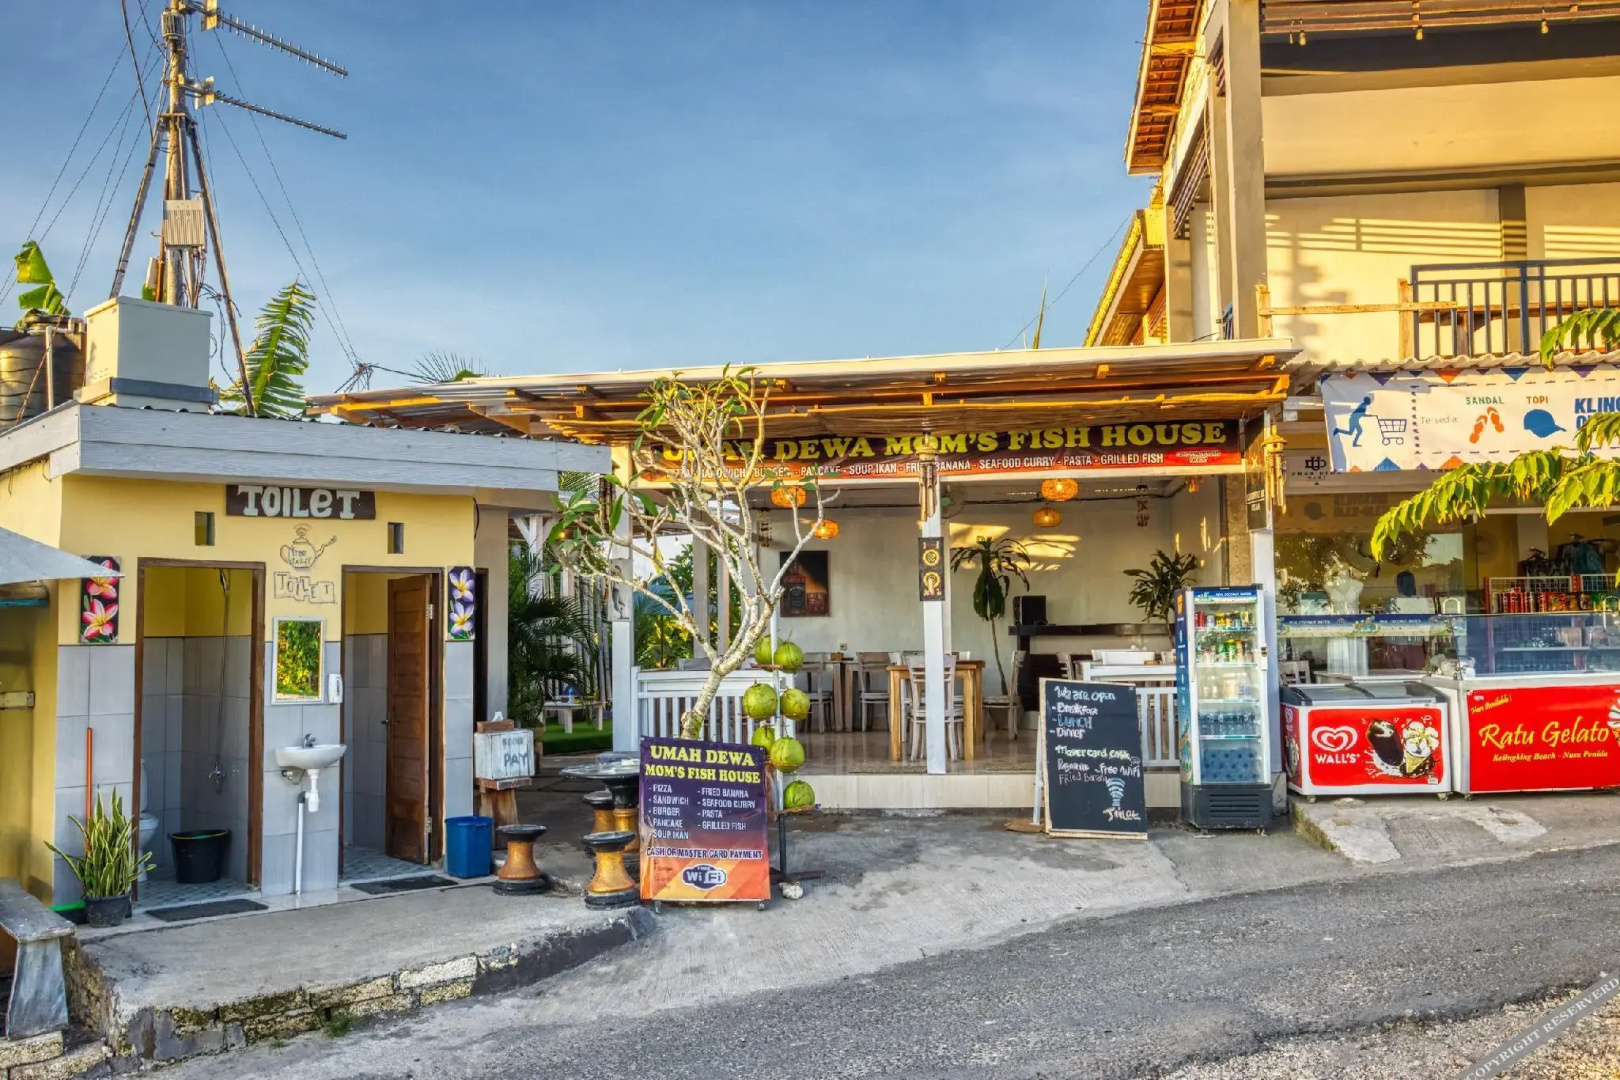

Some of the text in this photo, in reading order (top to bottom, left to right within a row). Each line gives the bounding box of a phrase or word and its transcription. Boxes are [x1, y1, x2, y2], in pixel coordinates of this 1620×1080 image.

[1465, 395, 1549, 405] SANDAL TOPI
[774, 437, 875, 460] DEWA
[885, 431, 998, 455] MOM'S
[1007, 426, 1090, 450] FISH
[1101, 422, 1226, 447] HOUSE
[849, 464, 873, 475] SOUP
[875, 463, 896, 474] IKAN
[979, 458, 1022, 468] SEAFOOD
[1024, 456, 1054, 467] CURRY
[1063, 455, 1093, 466] PASTA
[1101, 454, 1141, 465] GRILLED
[1142, 453, 1163, 463] FISH
[1072, 690, 1090, 700] are
[1091, 691, 1116, 703] open
[1478, 716, 1610, 749] Ratu Gelato
[503, 753, 530, 769] PAY
[650, 745, 755, 766] UMAH DEWA
[1314, 753, 1357, 764] WALL'S
[645, 764, 761, 784] MOM'S FISH HOUSE
[652, 784, 673, 793] PIZZA
[701, 787, 749, 798] FRIED BANANA
[652, 795, 689, 805] SANDWICH
[701, 798, 756, 809] SEAFOOD CURRY
[652, 806, 680, 816] BURGER
[702, 809, 723, 818] PASTA
[652, 818, 683, 828] PANCAKE
[702, 820, 747, 831] GRILLED FISH
[653, 829, 689, 840] SOUP IKAN
[646, 847, 665, 856] CASH
[678, 848, 707, 858] MASTER
[709, 849, 728, 859] CARD
[729, 850, 763, 859] PAYMENT
